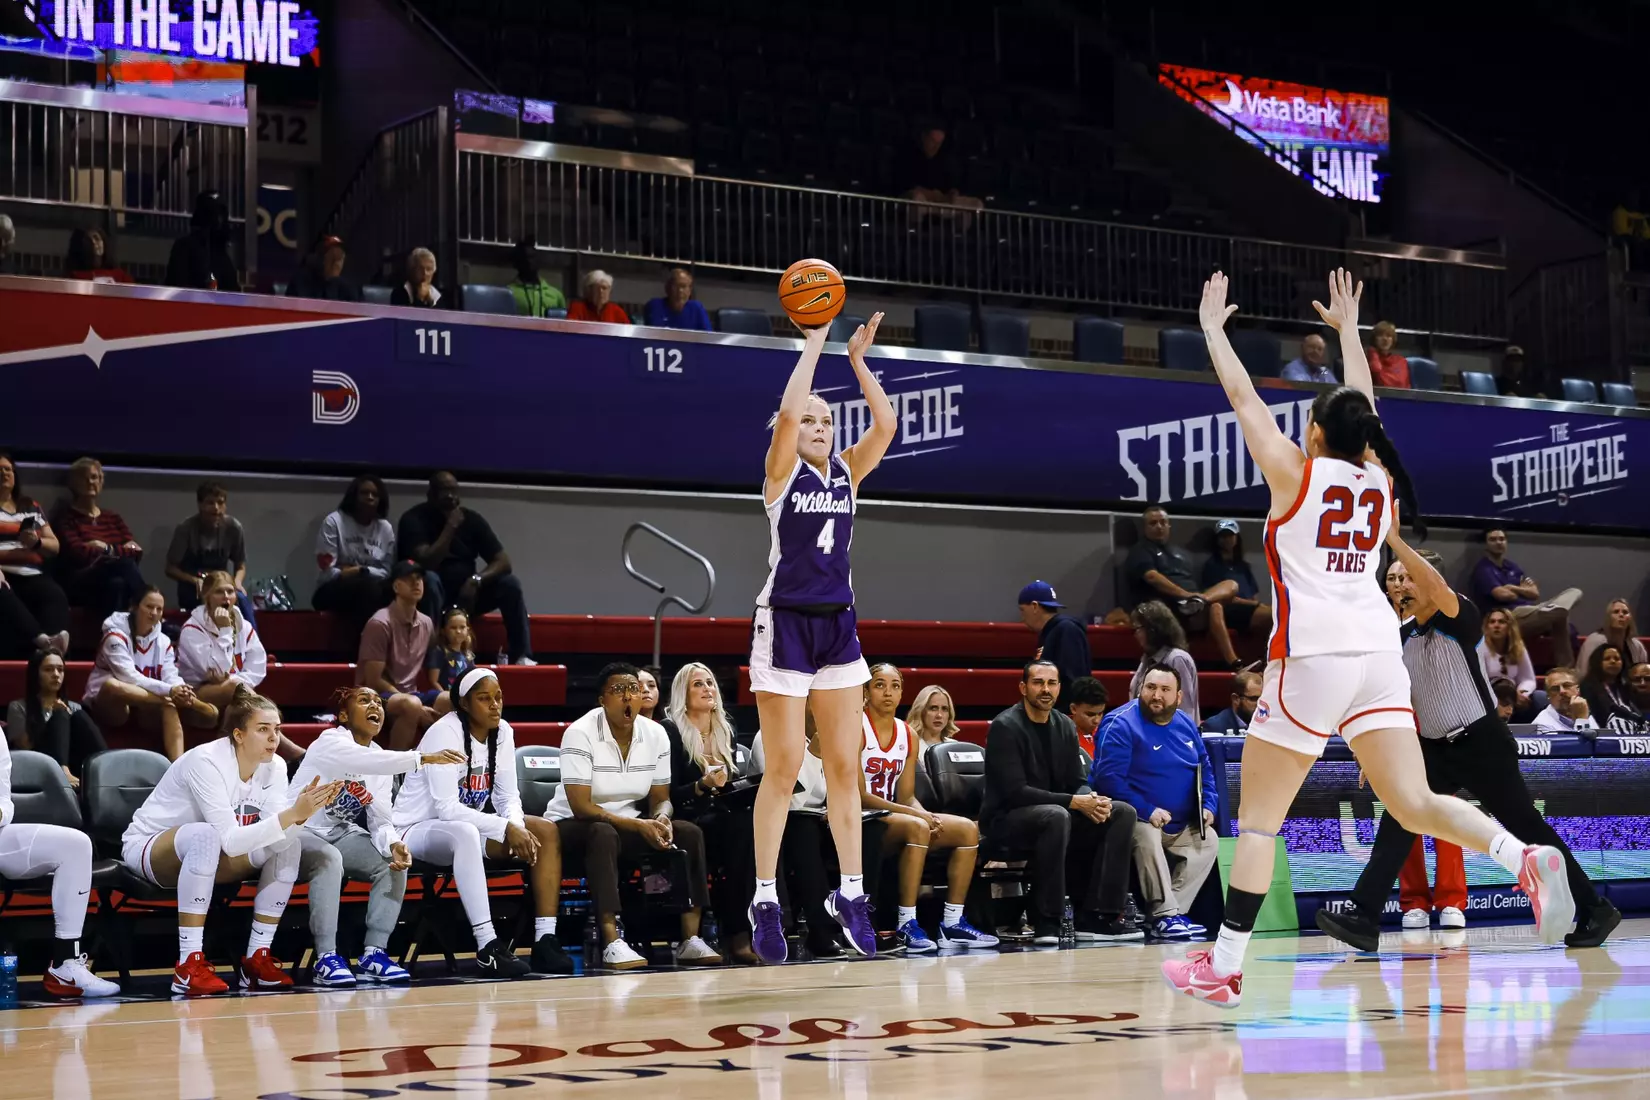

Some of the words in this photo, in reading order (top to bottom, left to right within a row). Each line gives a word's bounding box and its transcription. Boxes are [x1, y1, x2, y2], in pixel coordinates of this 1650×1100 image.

[52, 0, 95, 41] IN
[193, 0, 300, 67] GAME
[1244, 90, 1291, 122] Vista
[1293, 97, 1342, 130] Bank
[1312, 147, 1381, 203] GAME
[415, 328, 451, 356] 111
[643, 346, 683, 374] 112
[1549, 422, 1570, 443] THE
[1491, 434, 1628, 503] STAMPEDE
[816, 518, 836, 555] 4
[1316, 485, 1385, 553] 23
[1325, 551, 1367, 574] PARIS
[870, 772, 897, 802] 21
[1326, 900, 1344, 915] UT
[1465, 894, 1491, 910] dical
[292, 1011, 1139, 1078] Dallas
[256, 1058, 771, 1100] OODY
